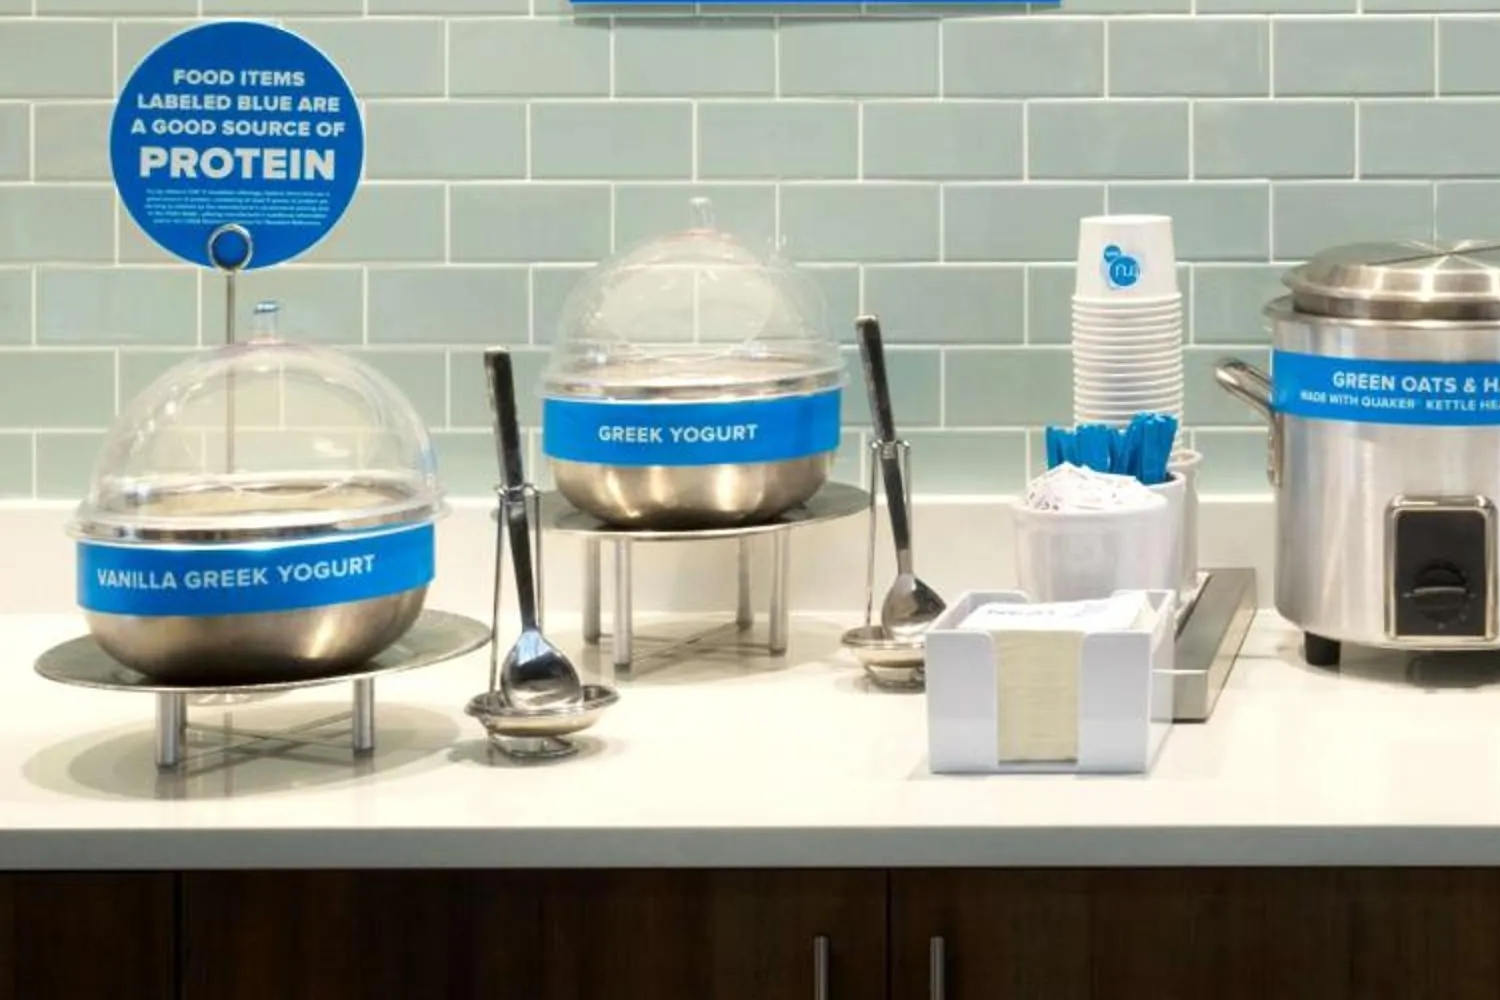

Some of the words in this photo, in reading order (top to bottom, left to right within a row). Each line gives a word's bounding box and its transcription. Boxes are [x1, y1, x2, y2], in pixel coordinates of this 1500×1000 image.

[173, 69, 234, 86] FOOD
[240, 70, 305, 87] ITEMS
[137, 93, 231, 111] LABELED
[237, 95, 292, 112] BLUE
[297, 97, 340, 112] ARE
[131, 118, 146, 134] A
[152, 119, 217, 136] GOOD
[222, 120, 310, 137] SOURCE
[316, 121, 345, 137] OF
[139, 146, 335, 181] PROTEIN
[1332, 371, 1395, 392] GREEN
[1401, 375, 1457, 393] OATS
[1463, 376, 1476, 393] &
[1329, 393, 1358, 407] WITH
[1425, 398, 1476, 411] KETTLE
[598, 425, 663, 443] GREEK
[670, 424, 758, 443] YOGURT
[97, 568, 177, 589] VANILLA
[184, 567, 268, 589] GREEK
[276, 554, 375, 582] YOGURT
